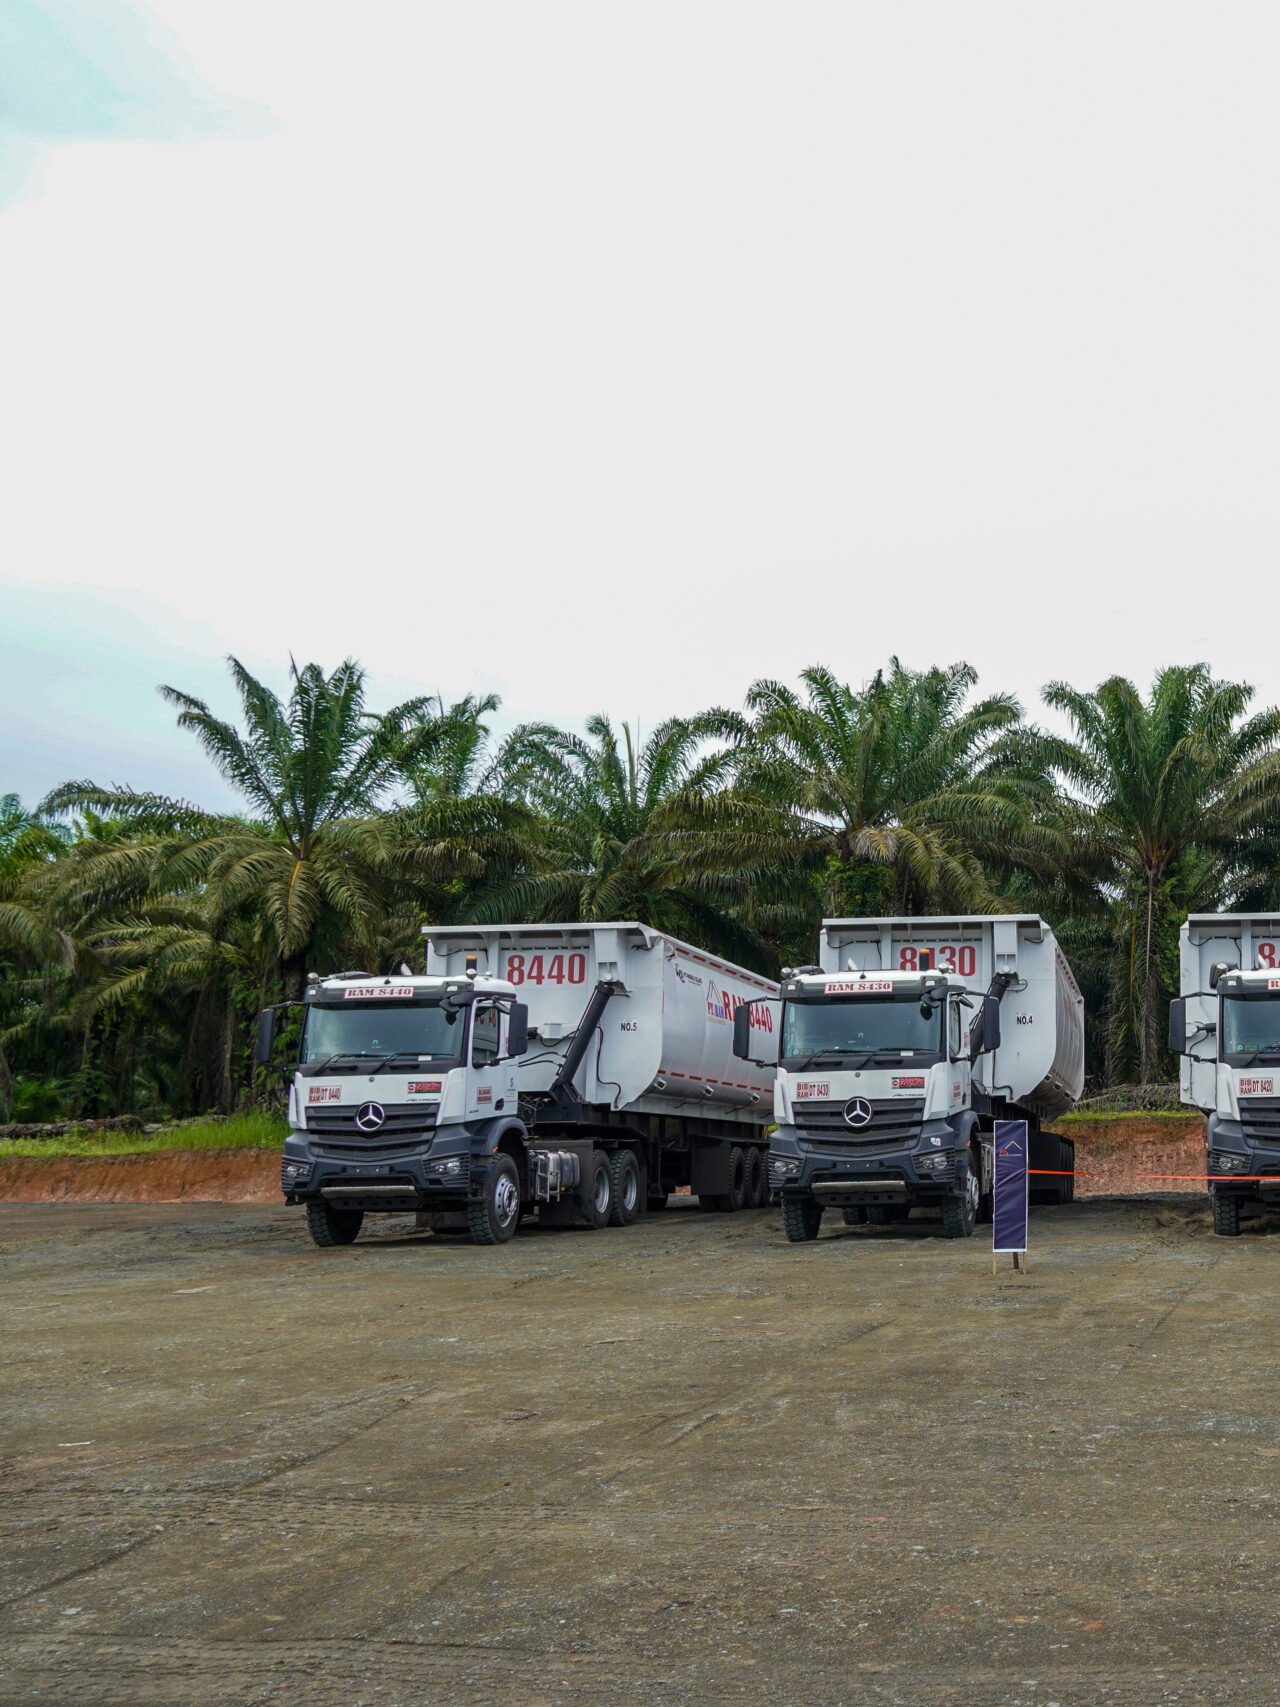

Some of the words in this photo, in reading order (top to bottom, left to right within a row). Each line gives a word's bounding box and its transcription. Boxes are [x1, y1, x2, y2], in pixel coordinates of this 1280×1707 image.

[507, 953, 585, 986] 8440
[348, 988, 374, 997] RAM
[378, 987, 411, 996] 8440
[827, 983, 854, 992] RAM
[858, 982, 891, 991] 8430
[1016, 1015, 1033, 1025] NO.4
[620, 1021, 637, 1032] NO.5
[809, 1085, 816, 1097] DT
[1252, 1081, 1259, 1093] DT
[320, 1088, 328, 1100] DT
